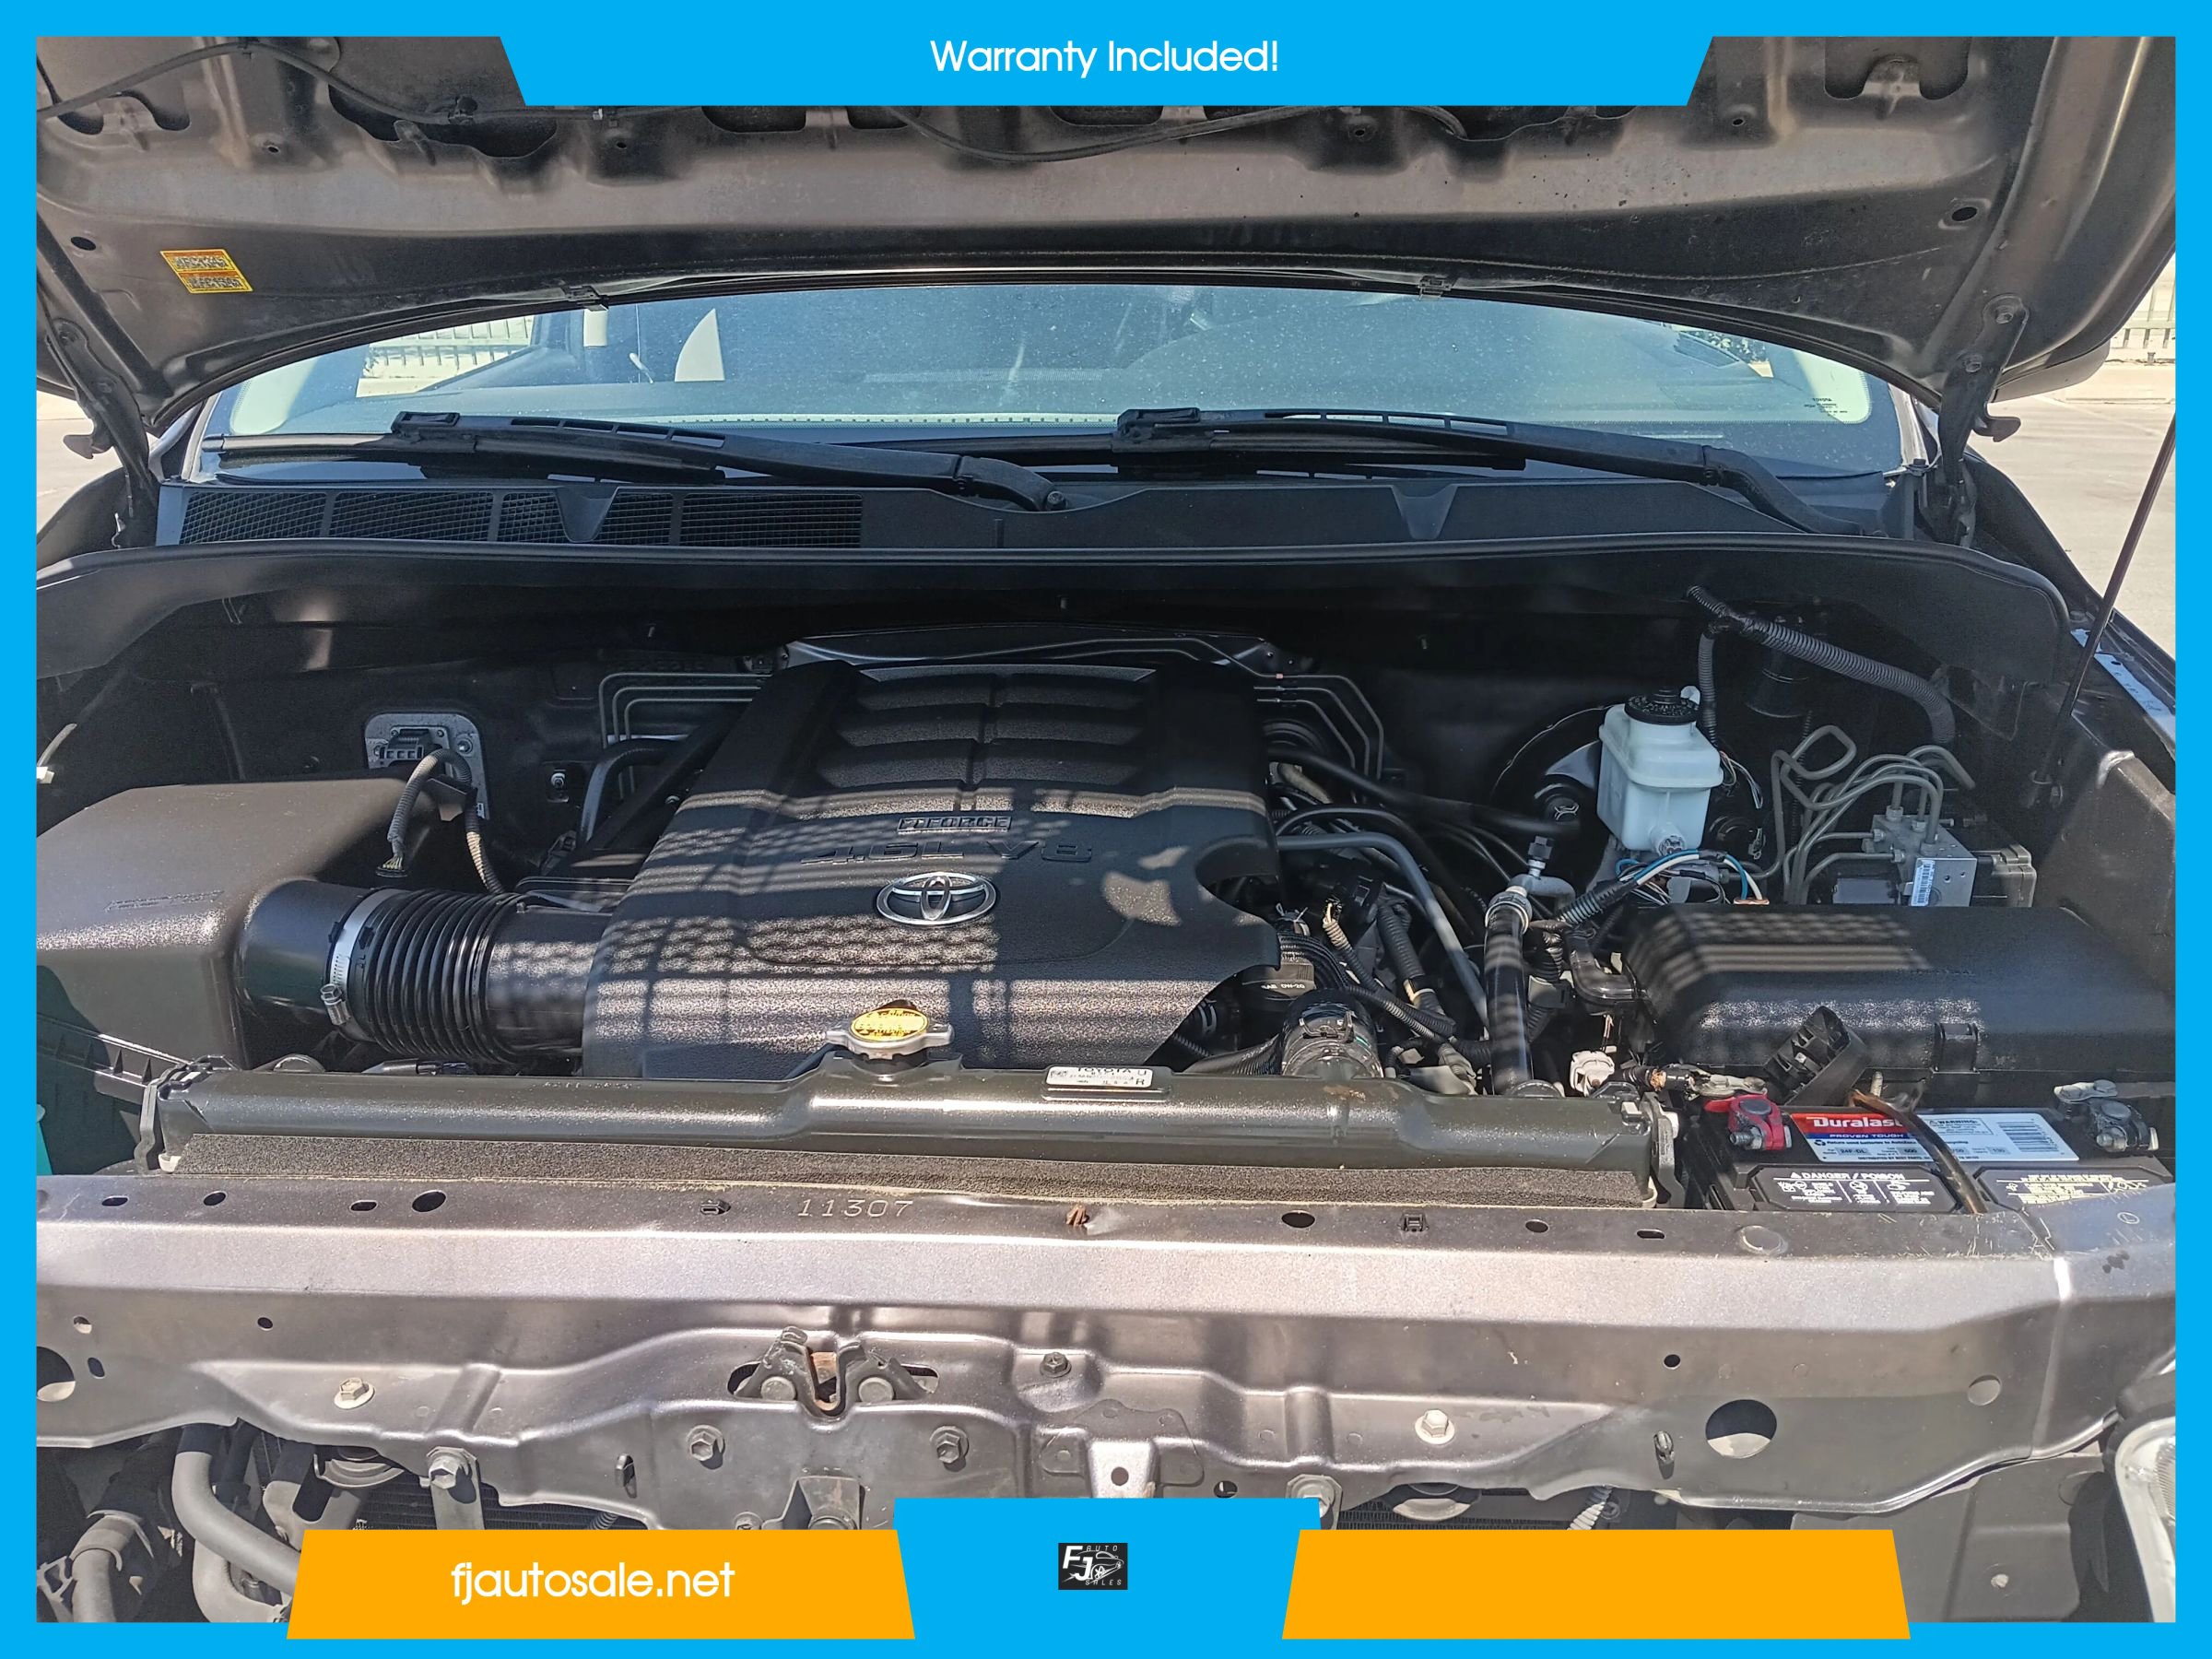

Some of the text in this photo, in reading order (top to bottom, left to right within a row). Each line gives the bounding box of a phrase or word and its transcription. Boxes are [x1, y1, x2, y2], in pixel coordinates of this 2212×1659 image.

[800, 840, 1092, 865] 4.6L V8
[797, 1199, 913, 1217] 11307
